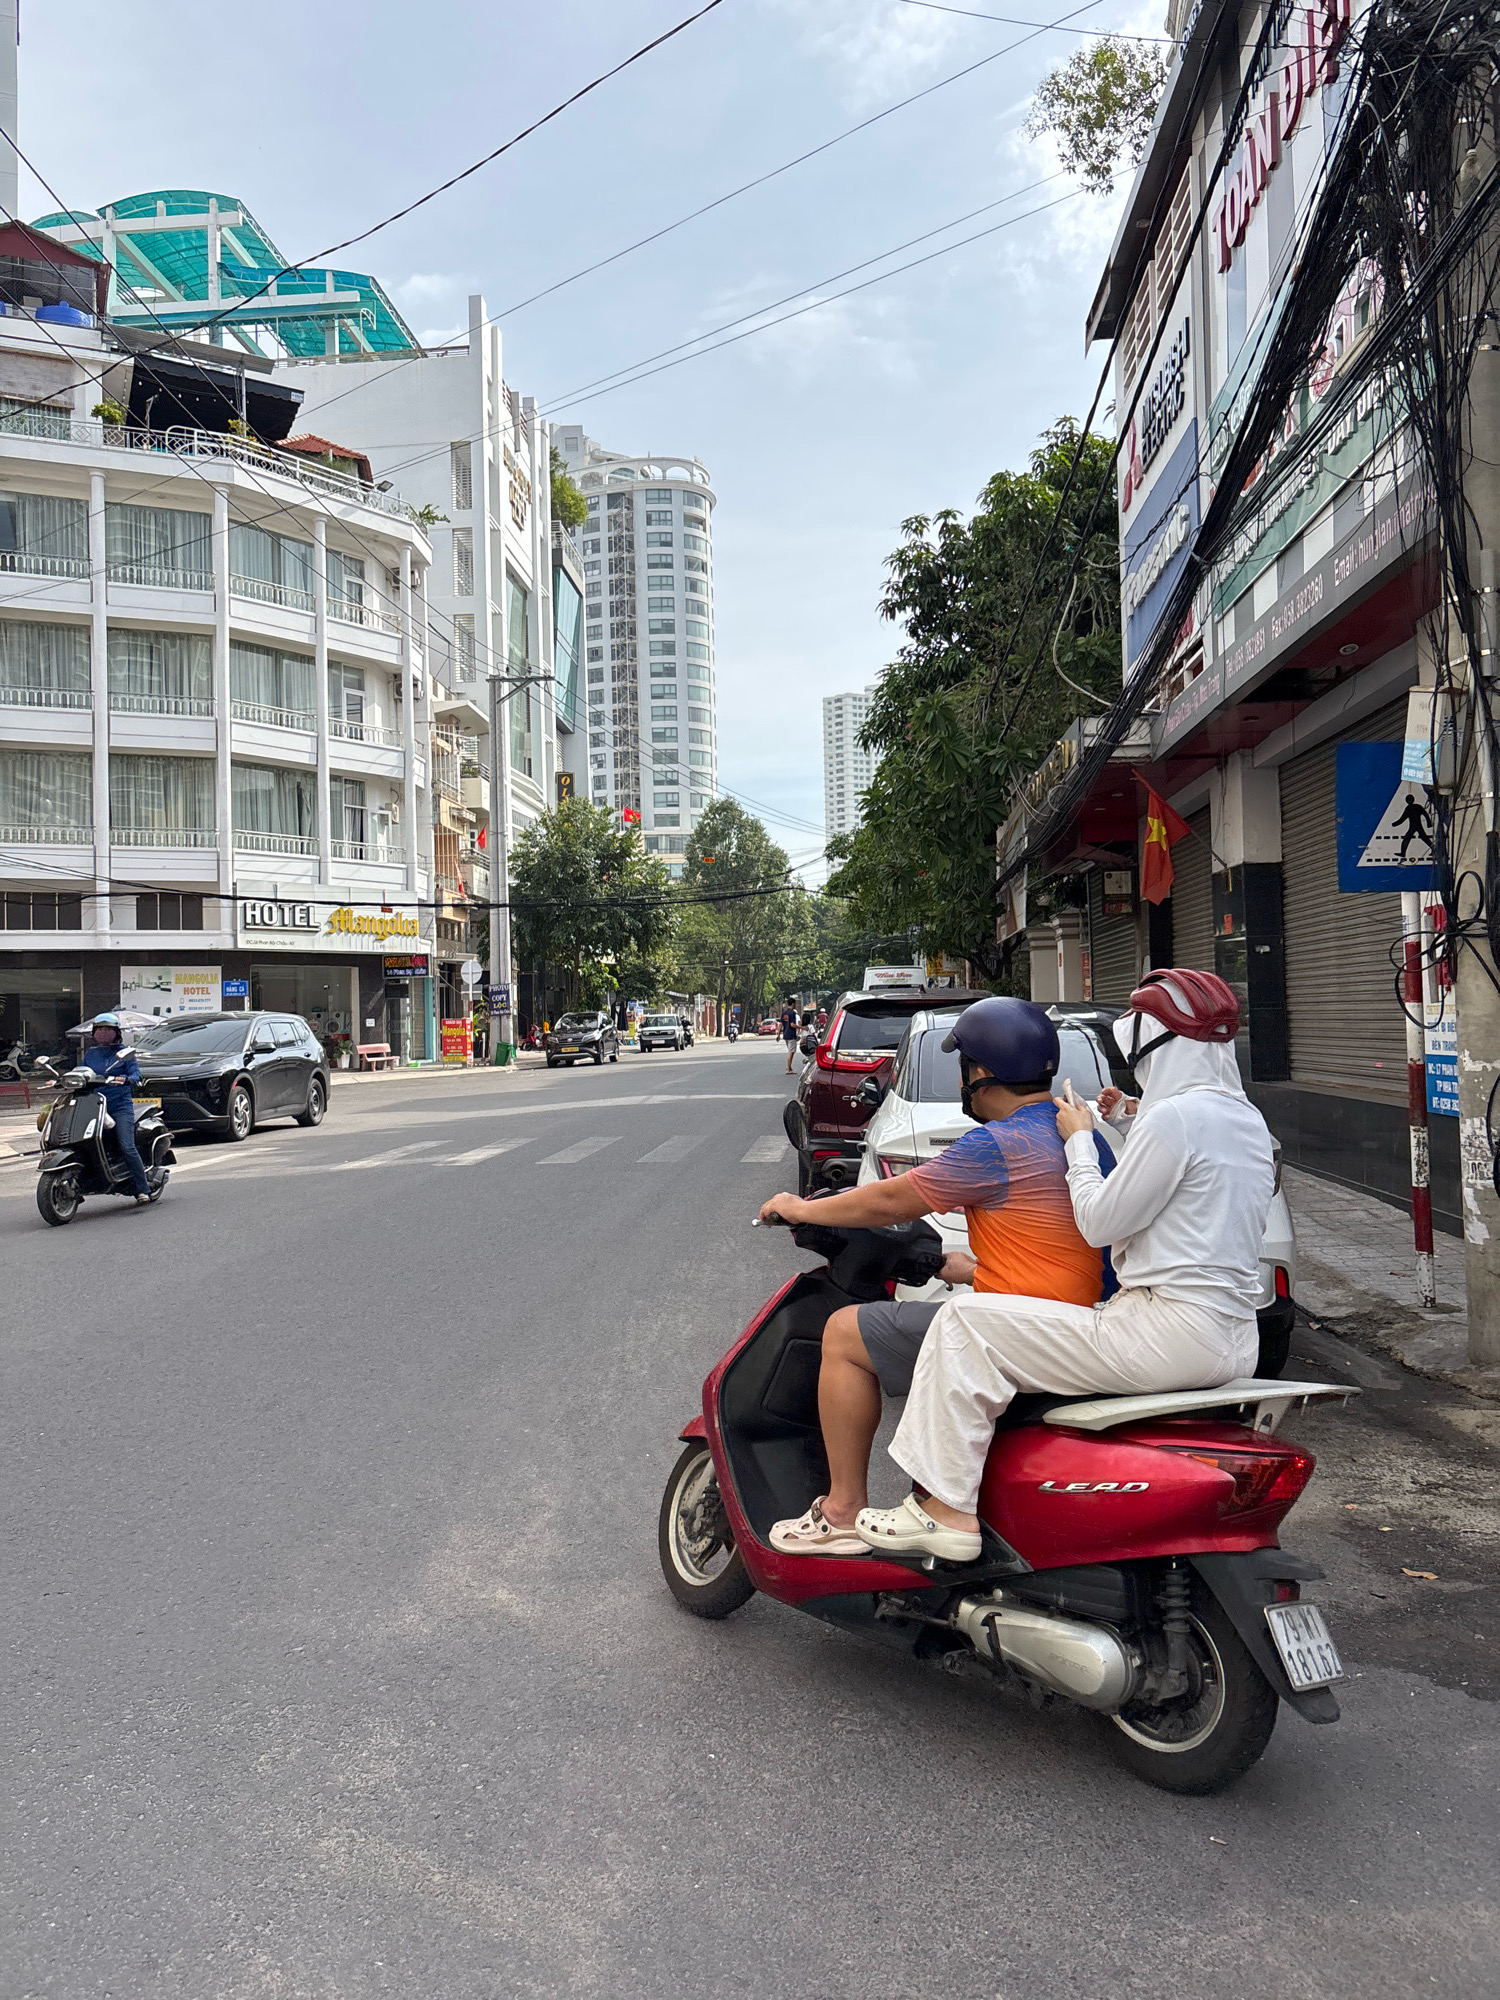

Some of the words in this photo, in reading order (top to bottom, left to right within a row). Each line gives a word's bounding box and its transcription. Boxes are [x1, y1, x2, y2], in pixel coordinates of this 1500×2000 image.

[1142, 316, 1190, 440] MITSUBISHI
[1142, 371, 1185, 475] ELECTRIC
[244, 902, 321, 928] HOTEL
[326, 907, 418, 940] Mangolia
[175, 973, 219, 984] MANGOLIA
[184, 987, 211, 995] HOTEL
[489, 984, 508, 992] PHOTO
[1039, 1480, 1150, 1493] LEAD
